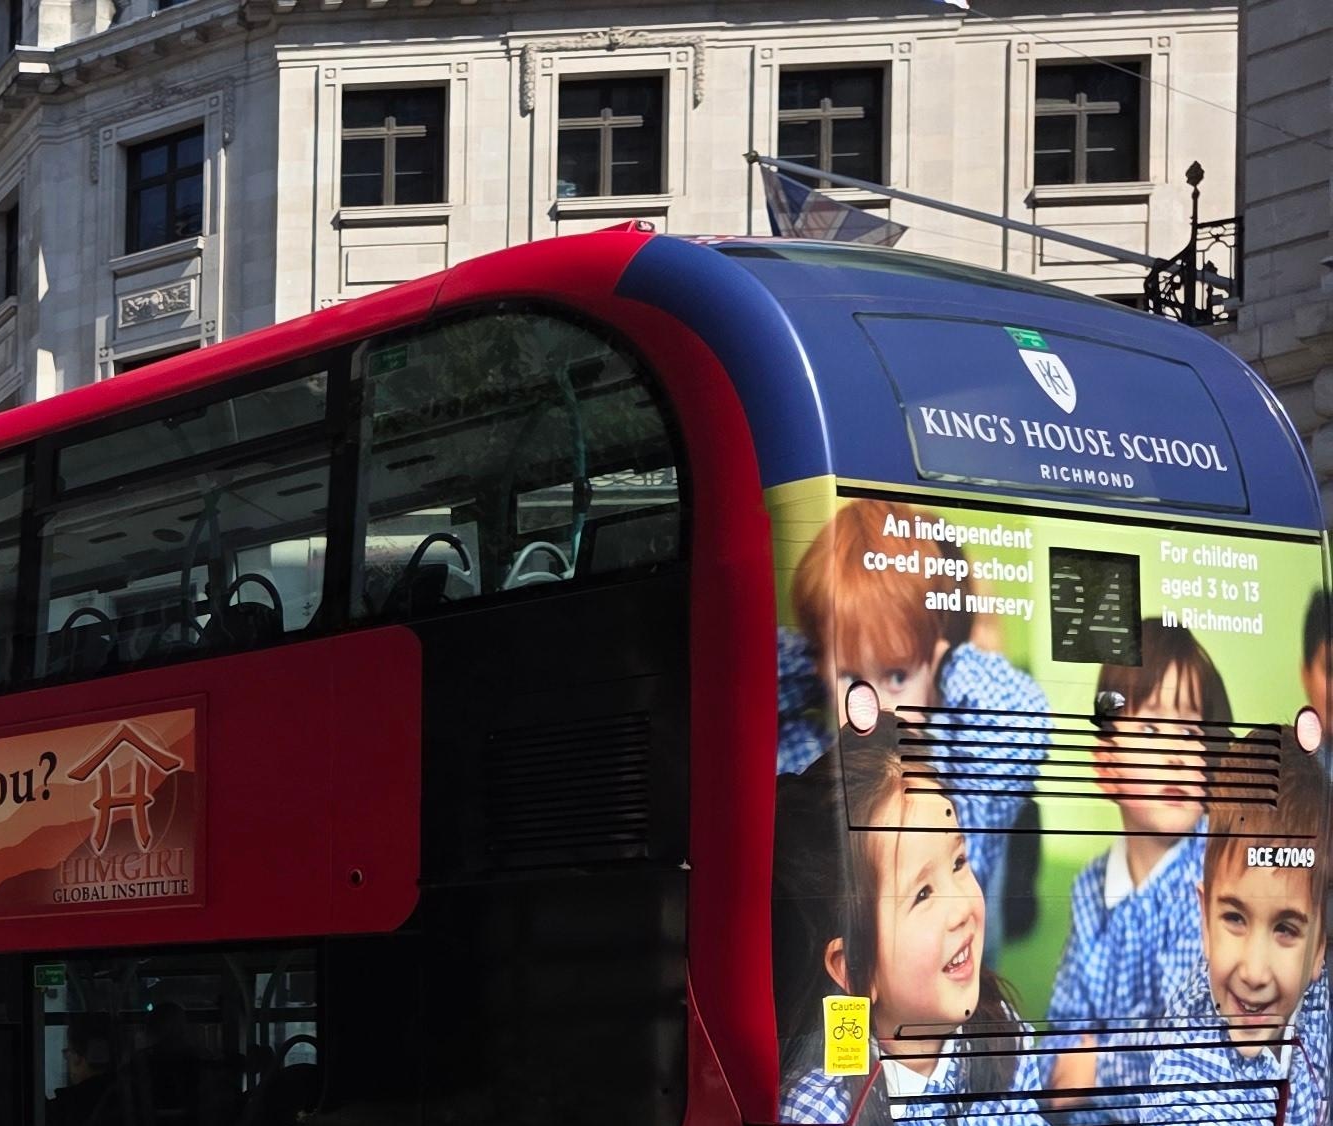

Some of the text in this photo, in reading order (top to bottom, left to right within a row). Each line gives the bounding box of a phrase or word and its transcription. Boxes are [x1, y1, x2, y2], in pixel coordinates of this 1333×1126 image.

[919, 406, 1228, 472] KING'S HOUSE SCHOOL
[1040, 464, 1134, 489] RICHMOND
[882, 514, 1034, 550] An independent
[863, 551, 1034, 584] co-ed prep school
[1160, 540, 1259, 572] For children
[1160, 577, 1260, 601] aged 3 to 13
[925, 589, 1034, 621] and nursery
[1161, 605, 1264, 636] in Richmond
[60, 848, 186, 885] HIMGIRI
[1248, 847, 1316, 869] BCE 47049
[52, 879, 189, 903] GLOBAL INSTITUTE
[830, 1002, 866, 1012] Caution
